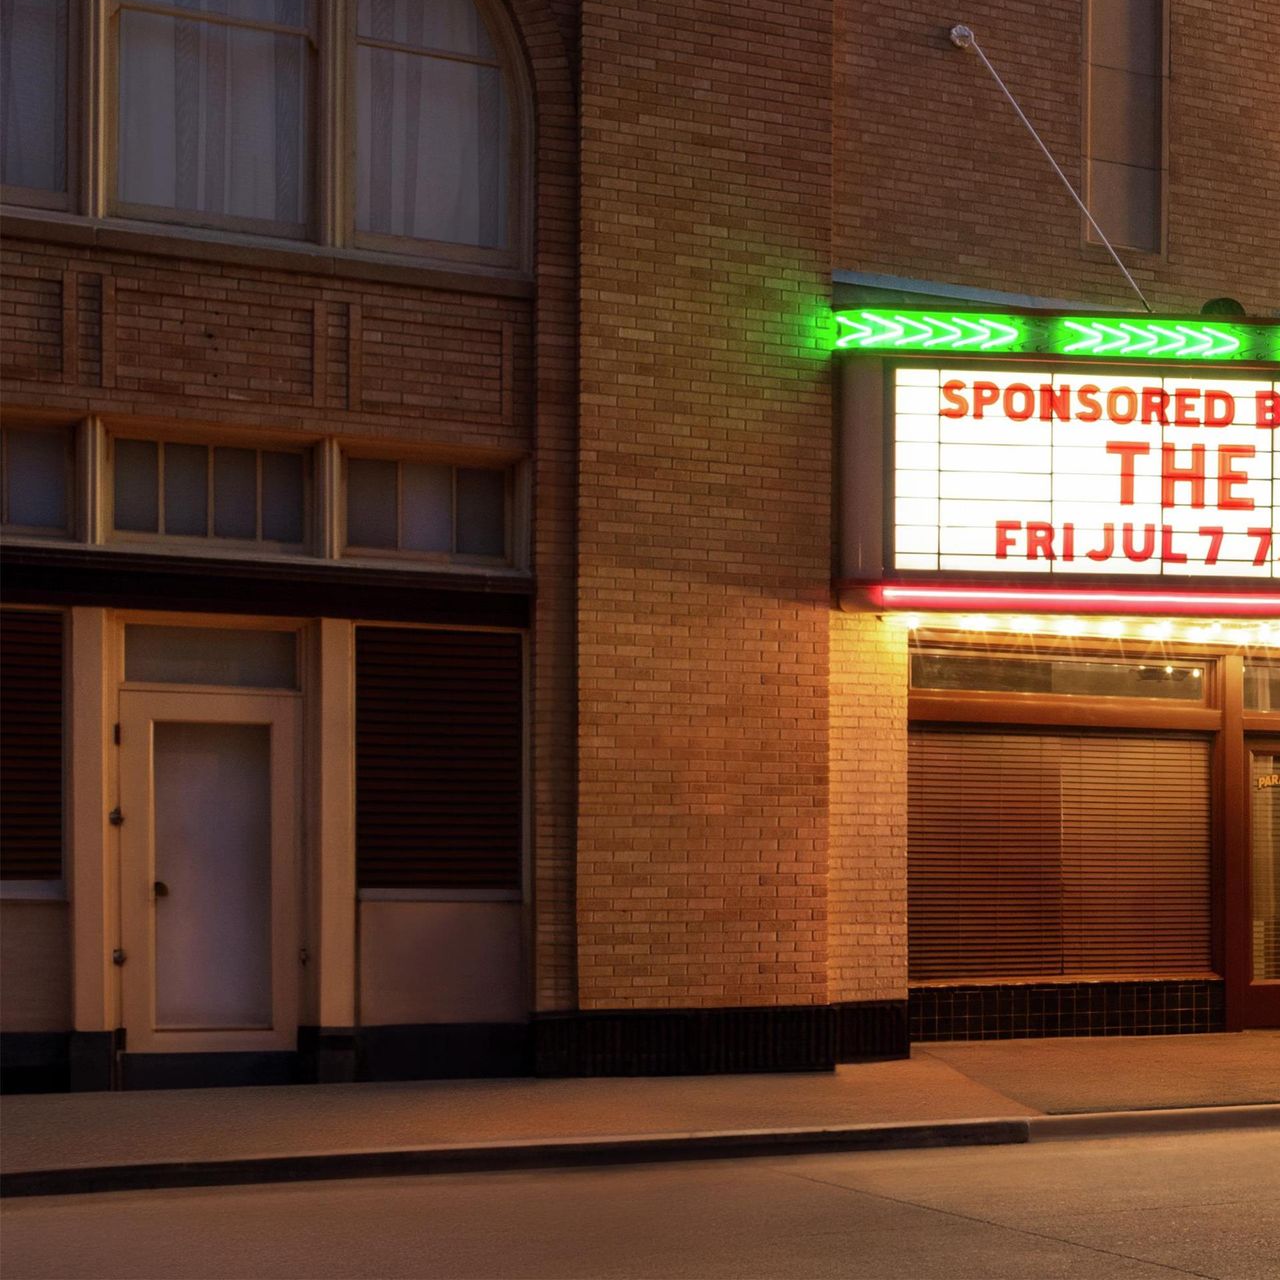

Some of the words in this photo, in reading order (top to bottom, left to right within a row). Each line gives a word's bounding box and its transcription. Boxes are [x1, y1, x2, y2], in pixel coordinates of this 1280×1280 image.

[940, 381, 1234, 427] SPONSORED
[1107, 442, 1255, 510] THE
[996, 521, 1074, 561] FRI
[1088, 524, 1187, 563] JUL
[1199, 527, 1223, 565] 7
